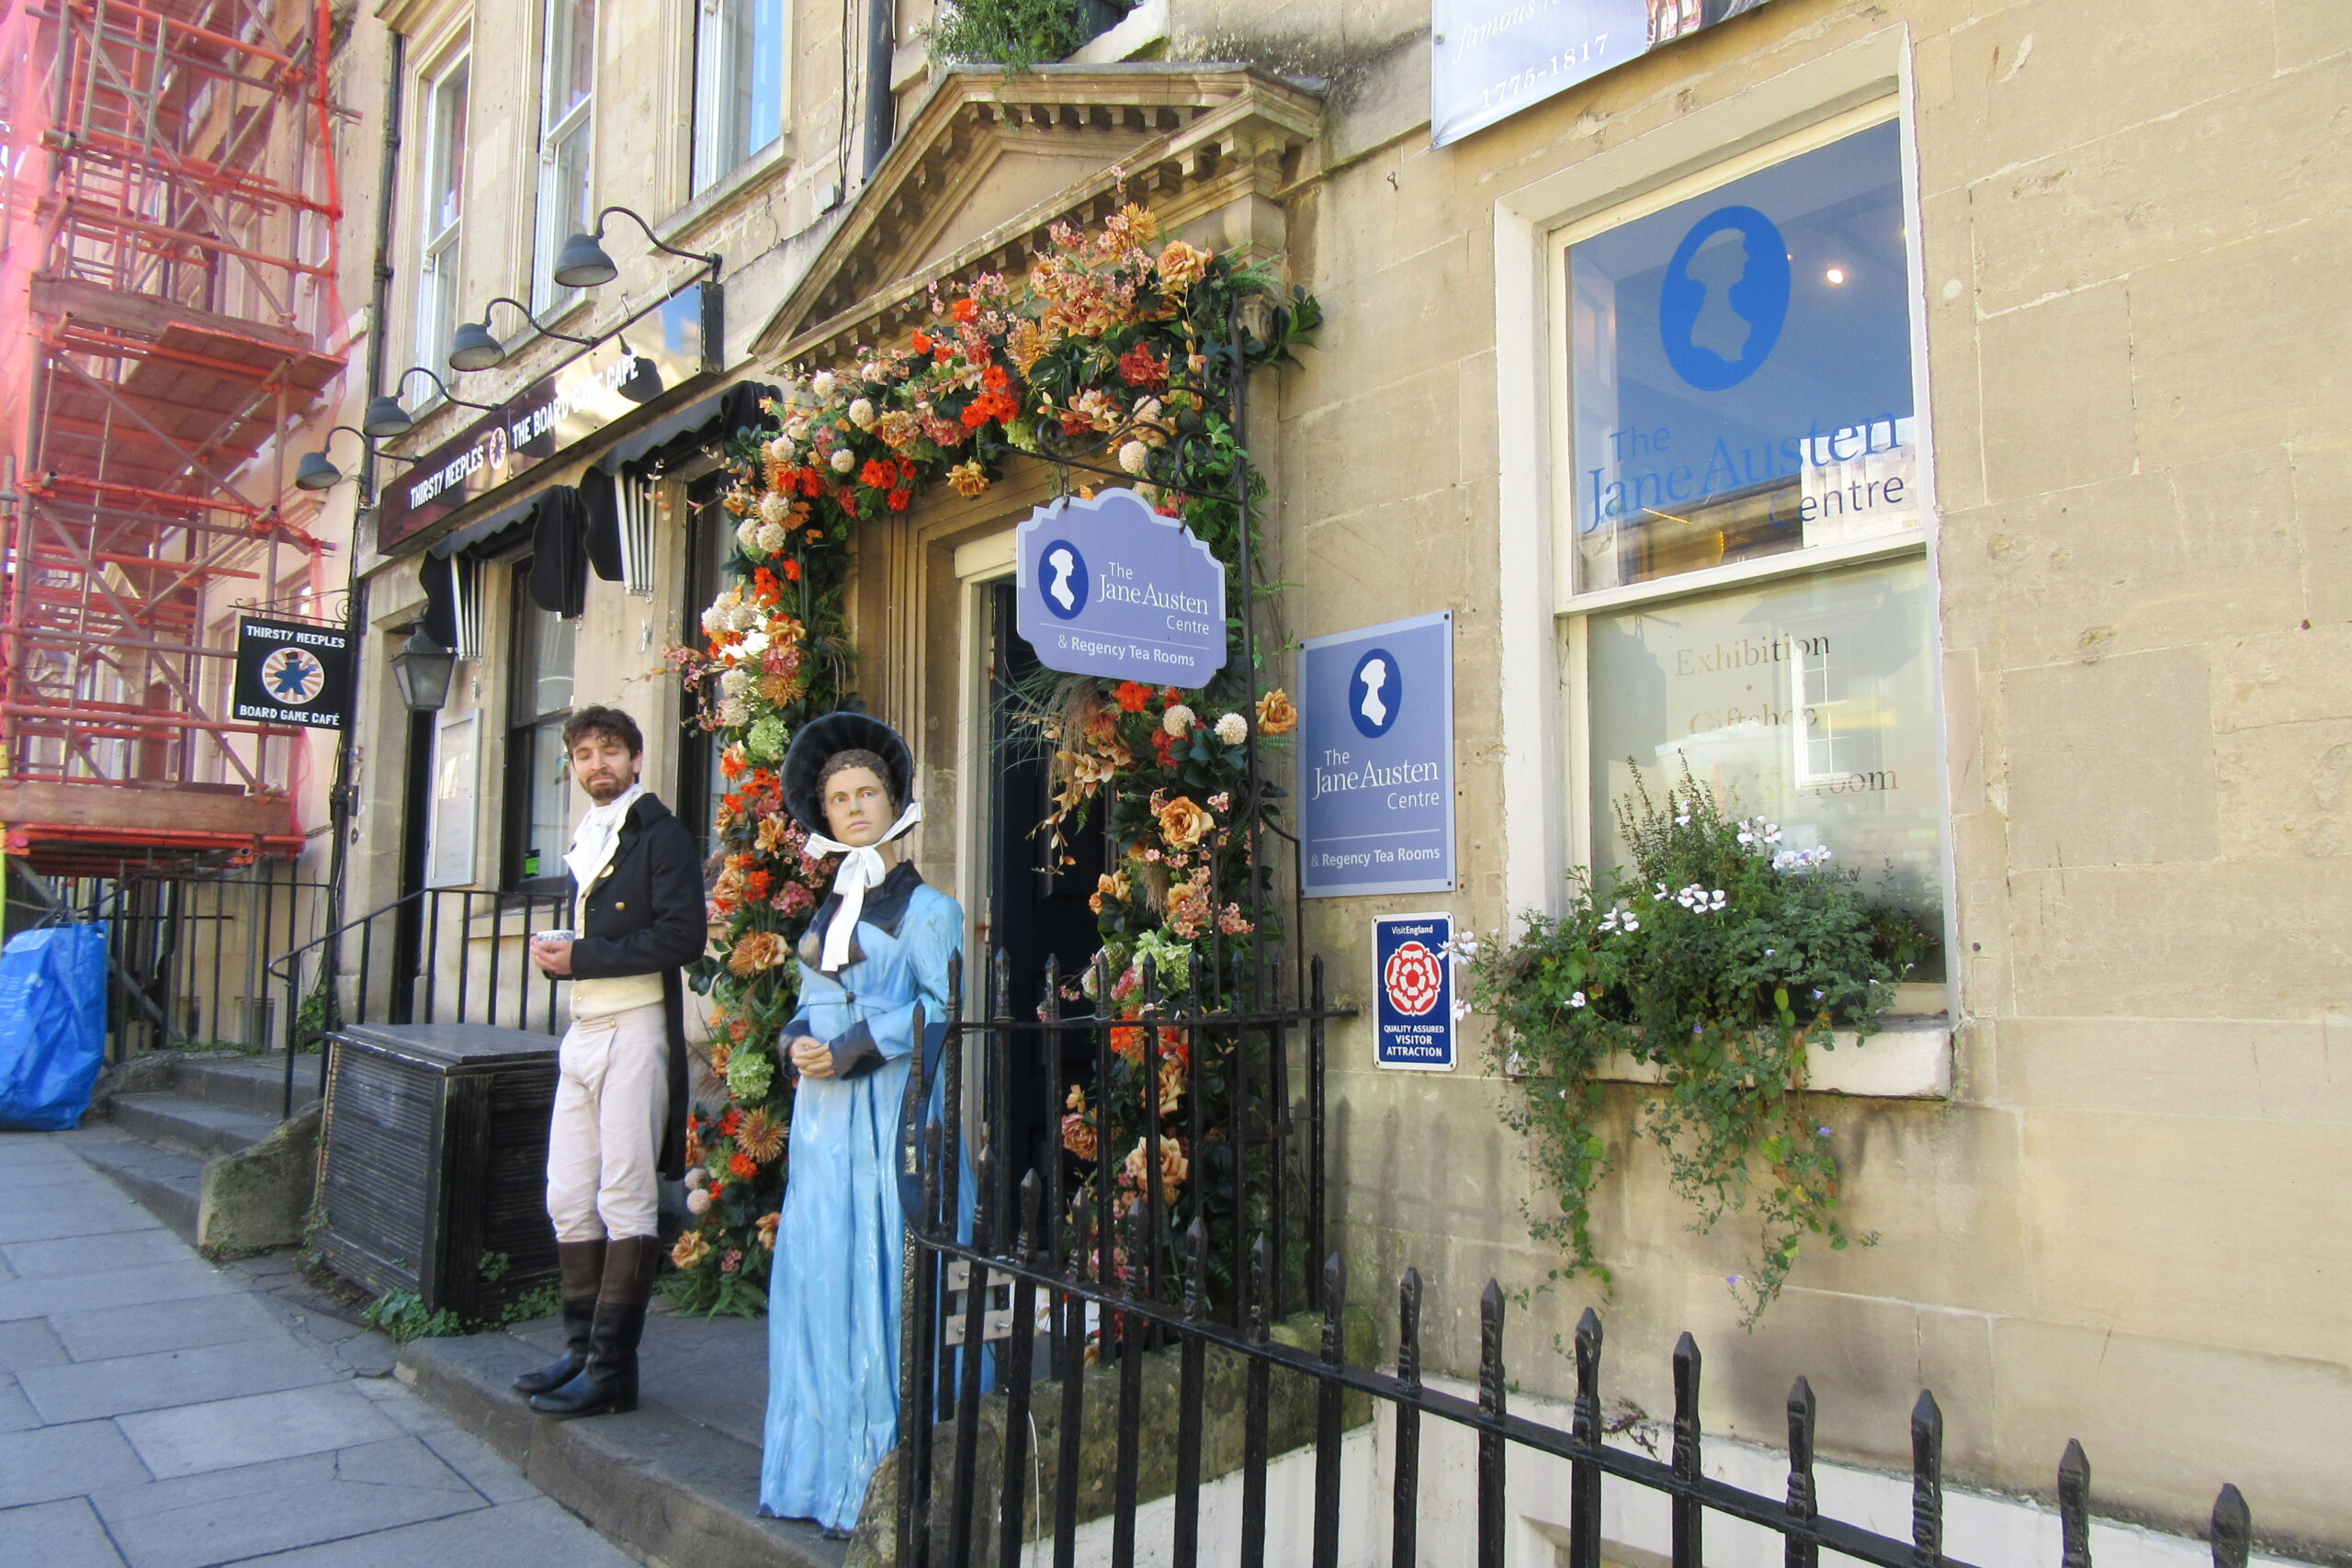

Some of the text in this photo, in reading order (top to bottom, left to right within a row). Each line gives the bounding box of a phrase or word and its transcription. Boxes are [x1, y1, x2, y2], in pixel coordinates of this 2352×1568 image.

[1453, 0, 1535, 64] famous
[1482, 32, 1609, 108] 1775-1817
[411, 469, 444, 510] THIRSTY
[445, 445, 484, 490] MEEPLES
[512, 415, 532, 450] THE
[533, 393, 570, 437] BOARD
[606, 344, 639, 393] CAFÉ
[1610, 425, 1671, 462] The
[1582, 412, 1903, 535] Jane Austen
[1768, 475, 1905, 528] Centre
[1108, 561, 1133, 580] The
[1096, 573, 1208, 615] Jane Austen
[1166, 615, 1210, 635] Centre
[246, 625, 345, 649] THIRSTY MEEPLES
[1057, 634, 1194, 667] & Regency Tea Rooms
[240, 705, 340, 726] BOARD GAME CAFÉ
[1324, 749, 1350, 766] The
[1311, 760, 1440, 800] Jane Austen
[1387, 791, 1440, 809] Centre
[1310, 848, 1440, 869] & Regency Tea Rooms
[1391, 924, 1433, 935] VisitEngland
[1384, 1025, 1444, 1033] QUALITY ASSURED
[1396, 1034, 1432, 1044] VISITOR
[1386, 1046, 1442, 1057] ATTRACTION
